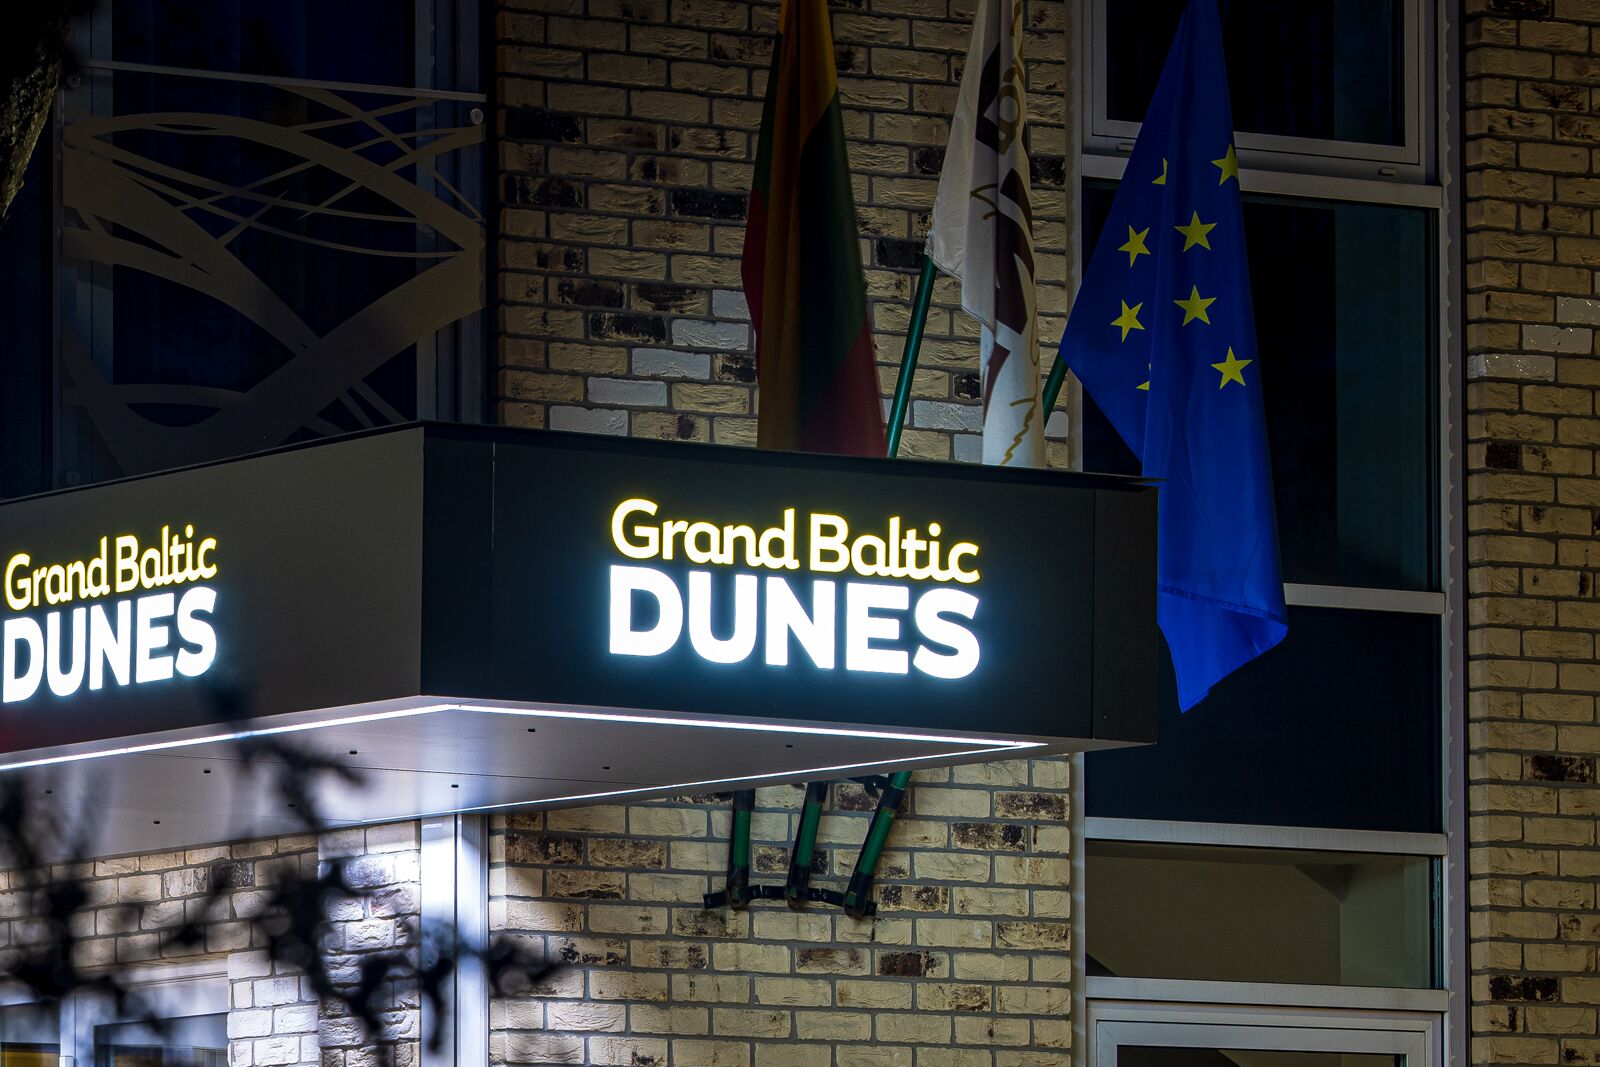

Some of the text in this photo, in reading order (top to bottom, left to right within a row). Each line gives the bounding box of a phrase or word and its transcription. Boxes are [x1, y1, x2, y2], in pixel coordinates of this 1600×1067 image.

[4, 523, 218, 611] Grand Baltic
[611, 498, 981, 584] Grand Baltic
[2, 586, 217, 704] DUNES
[609, 564, 981, 680] DUNES
